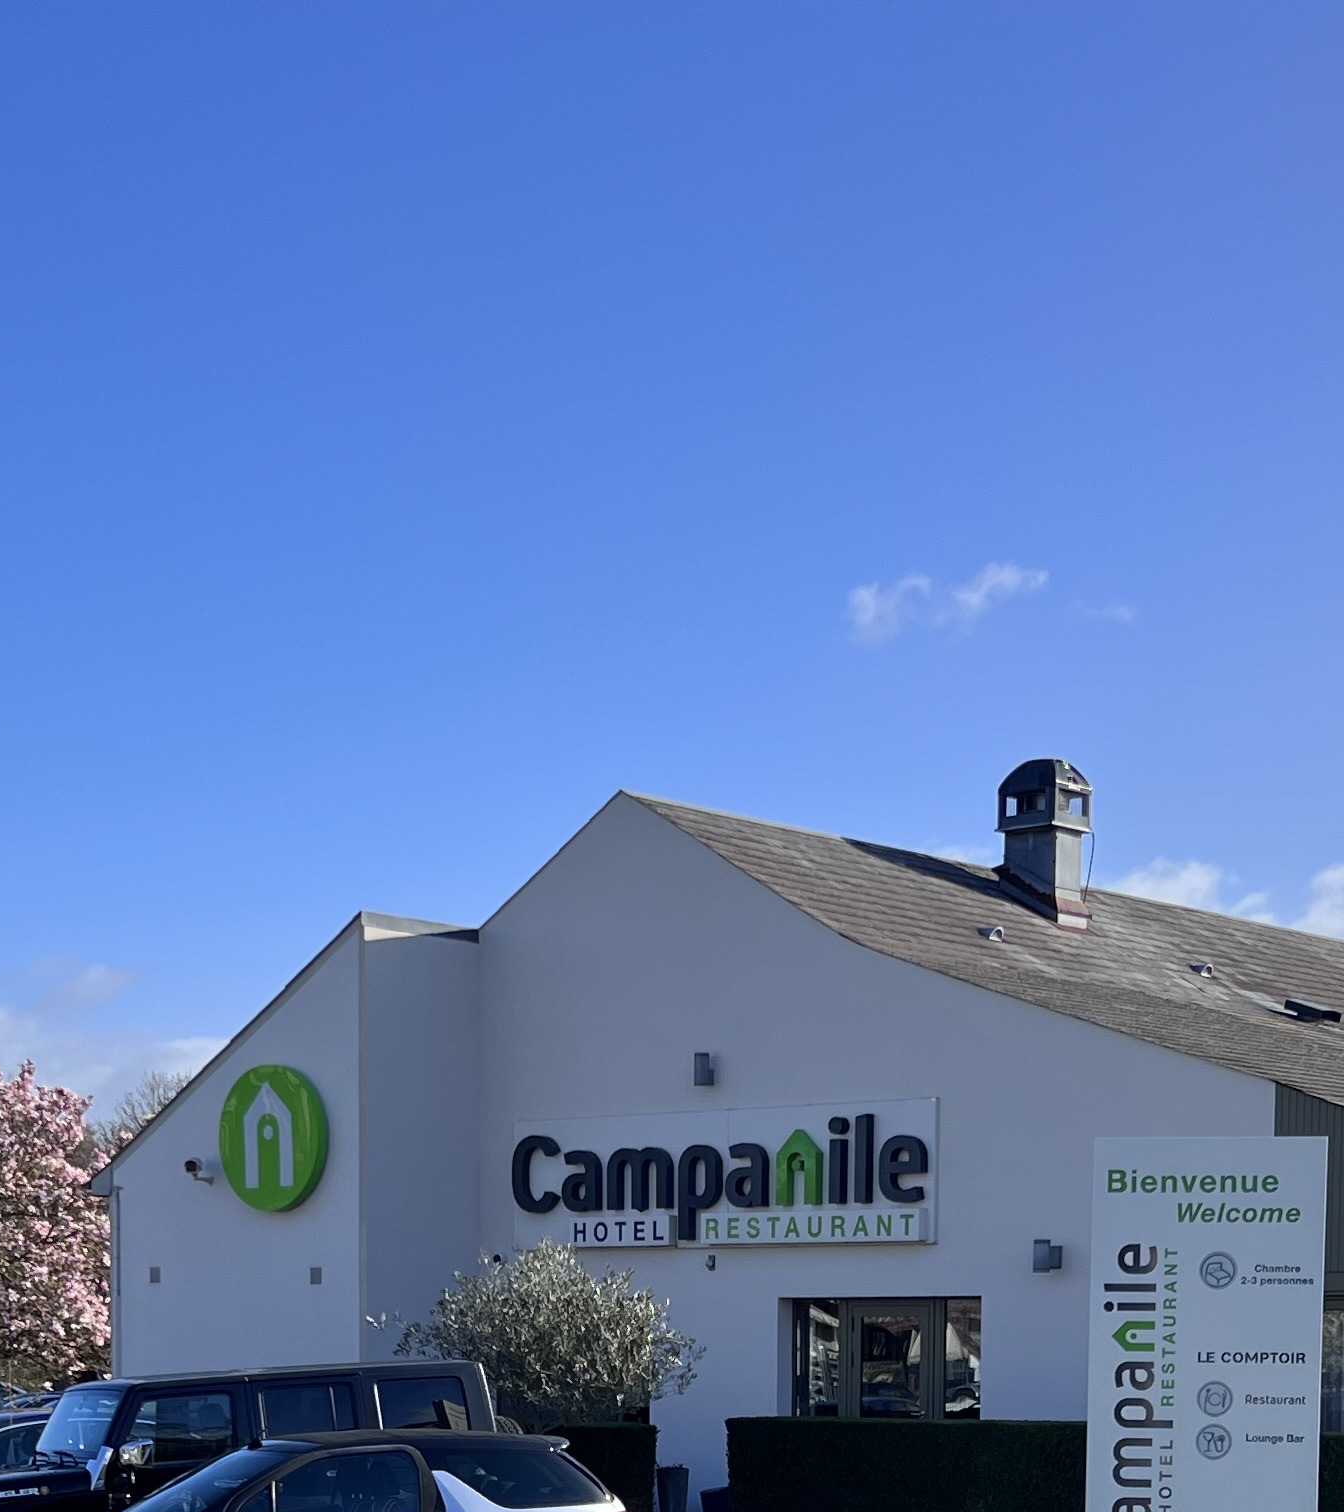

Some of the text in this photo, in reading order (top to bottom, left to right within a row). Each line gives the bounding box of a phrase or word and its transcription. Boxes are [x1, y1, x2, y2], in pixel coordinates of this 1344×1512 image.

[512, 1113, 929, 1241] Campanile
[1107, 1169, 1280, 1194] Bienvenue
[1176, 1202, 1302, 1224] Welcome
[573, 1214, 916, 1243] HOTEL RESTAURANT
[1254, 1264, 1301, 1274] Chambre
[1240, 1277, 1314, 1287] 2-3 personnes
[1160, 1247, 1179, 1407] RESTAURANT
[1197, 1351, 1306, 1364] LE COMPTOIR
[1244, 1393, 1307, 1406] Restaurant
[1245, 1433, 1305, 1445] Lounge Bar
